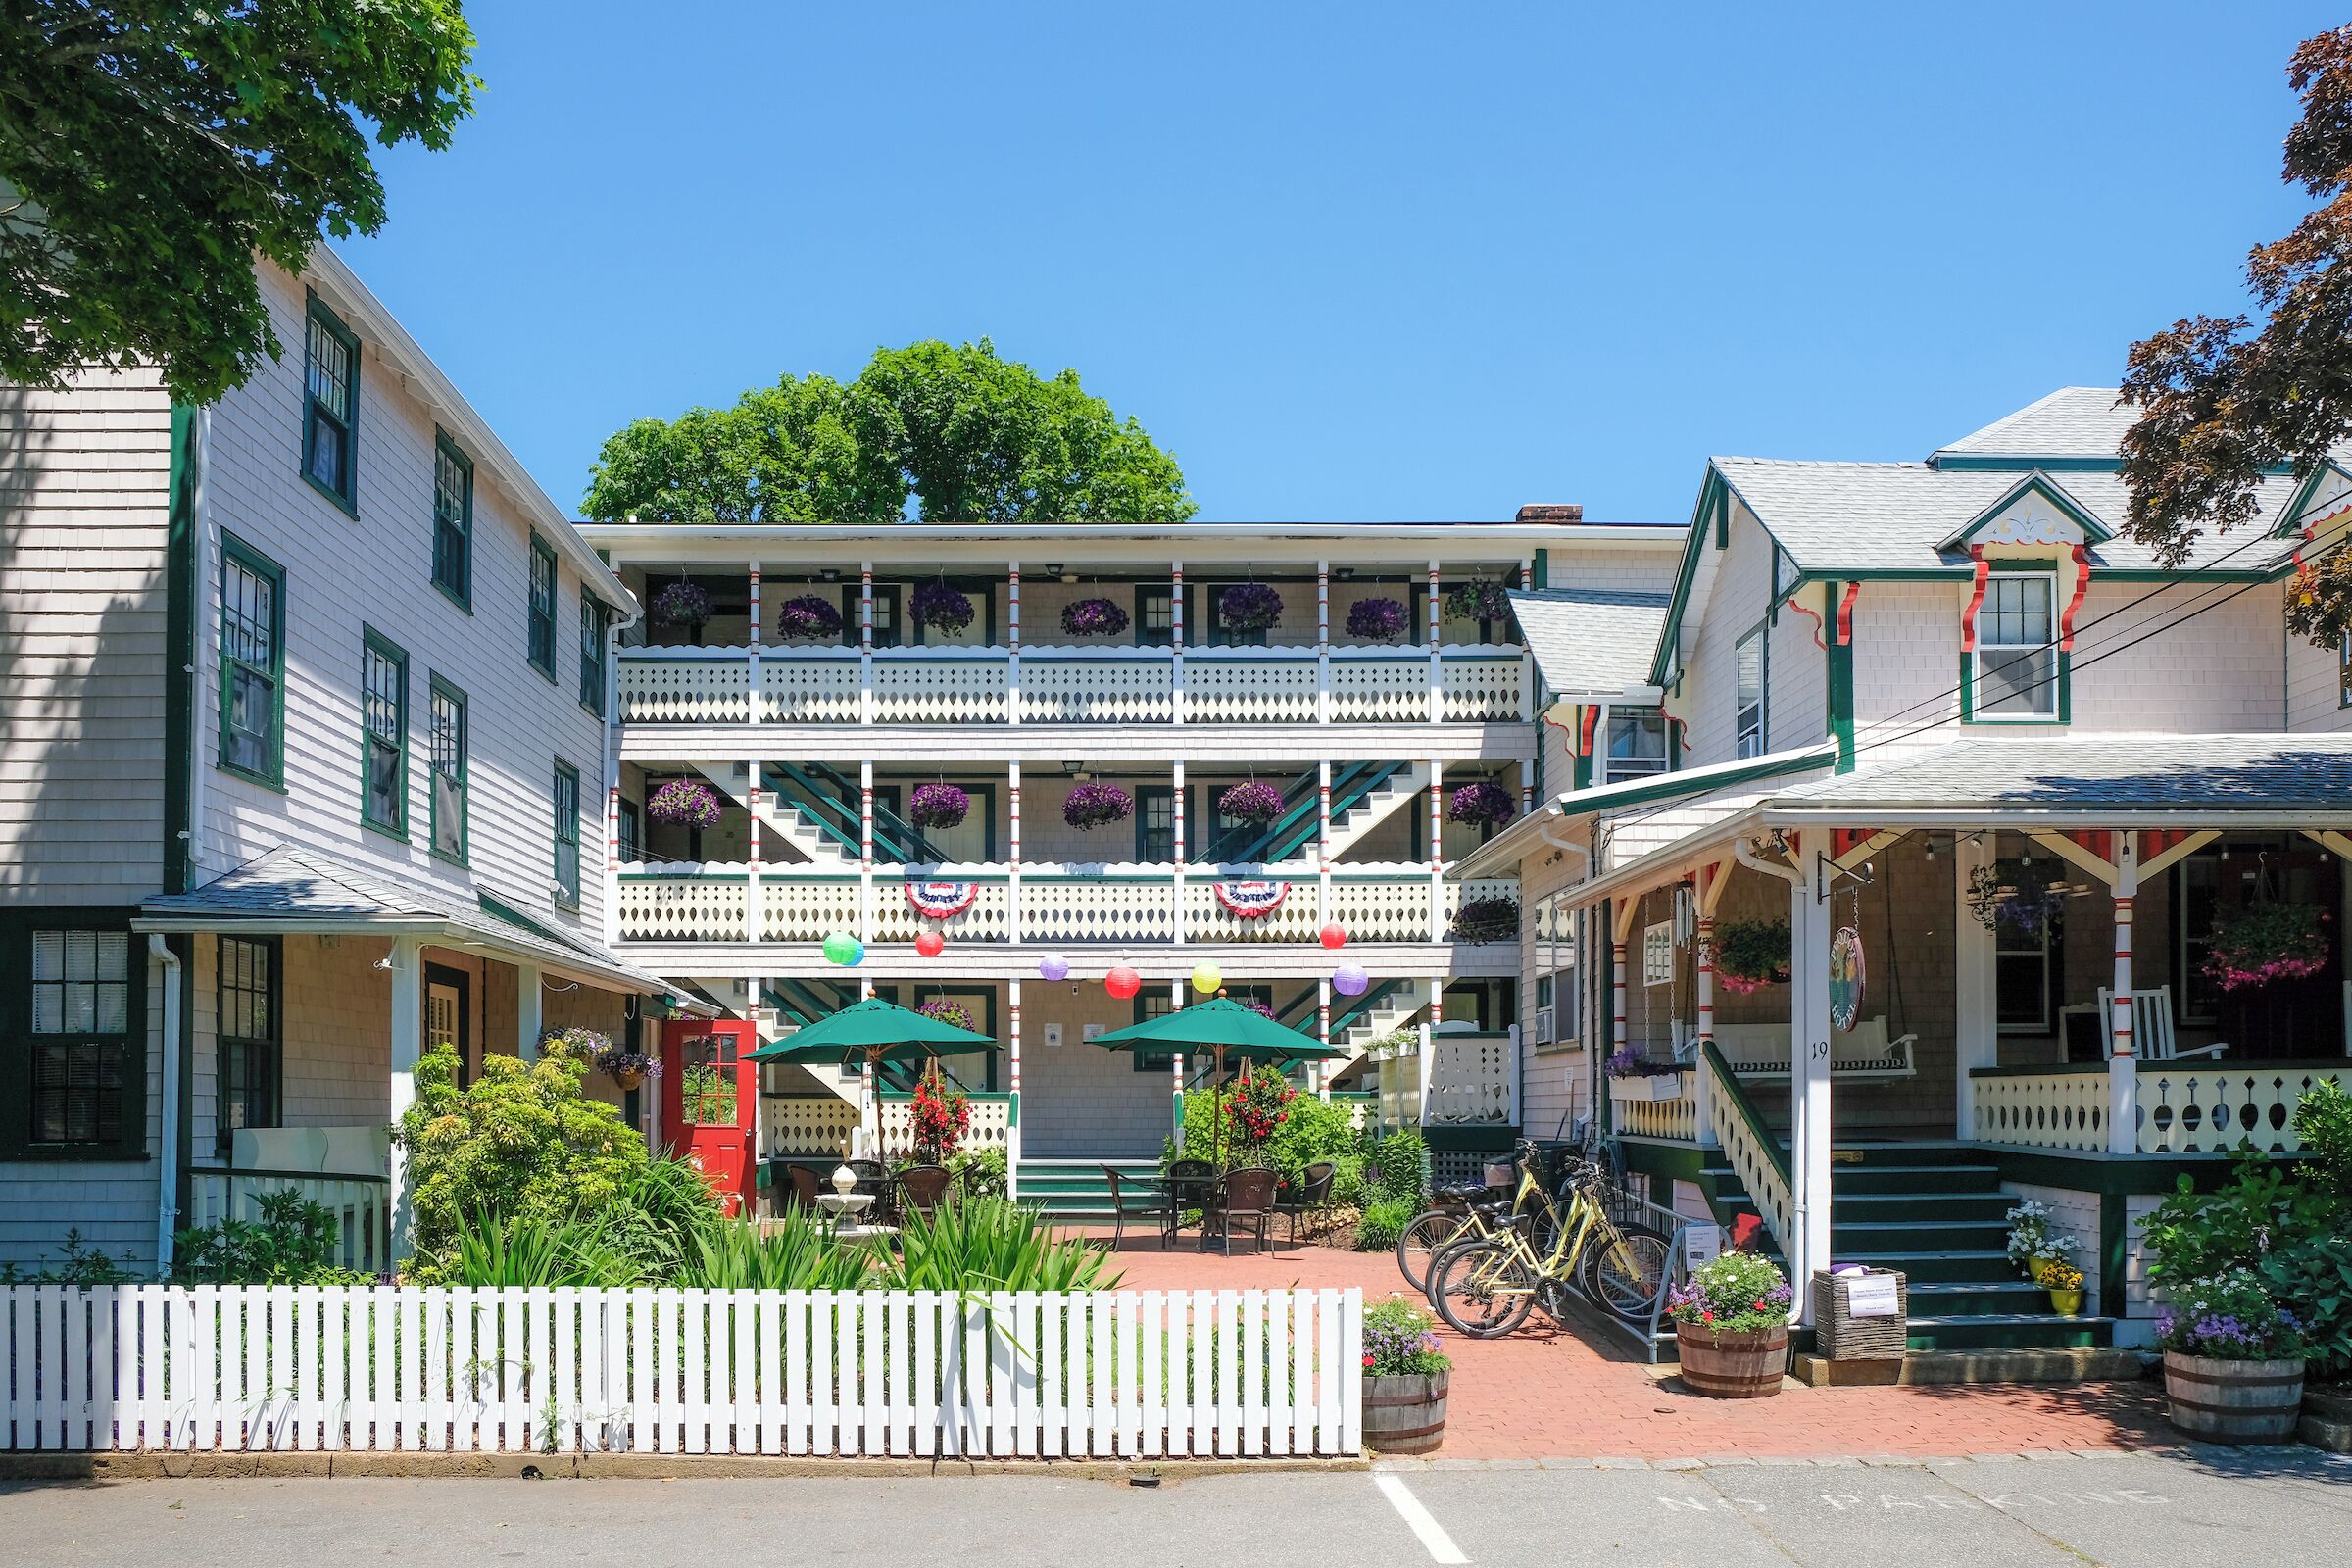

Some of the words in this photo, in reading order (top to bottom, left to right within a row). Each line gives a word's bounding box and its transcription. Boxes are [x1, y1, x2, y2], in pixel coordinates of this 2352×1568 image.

[1831, 930, 1857, 960] PEQUOT
[1831, 1003, 1857, 1029] HOTEL
[1812, 1041, 1829, 1060] 19
